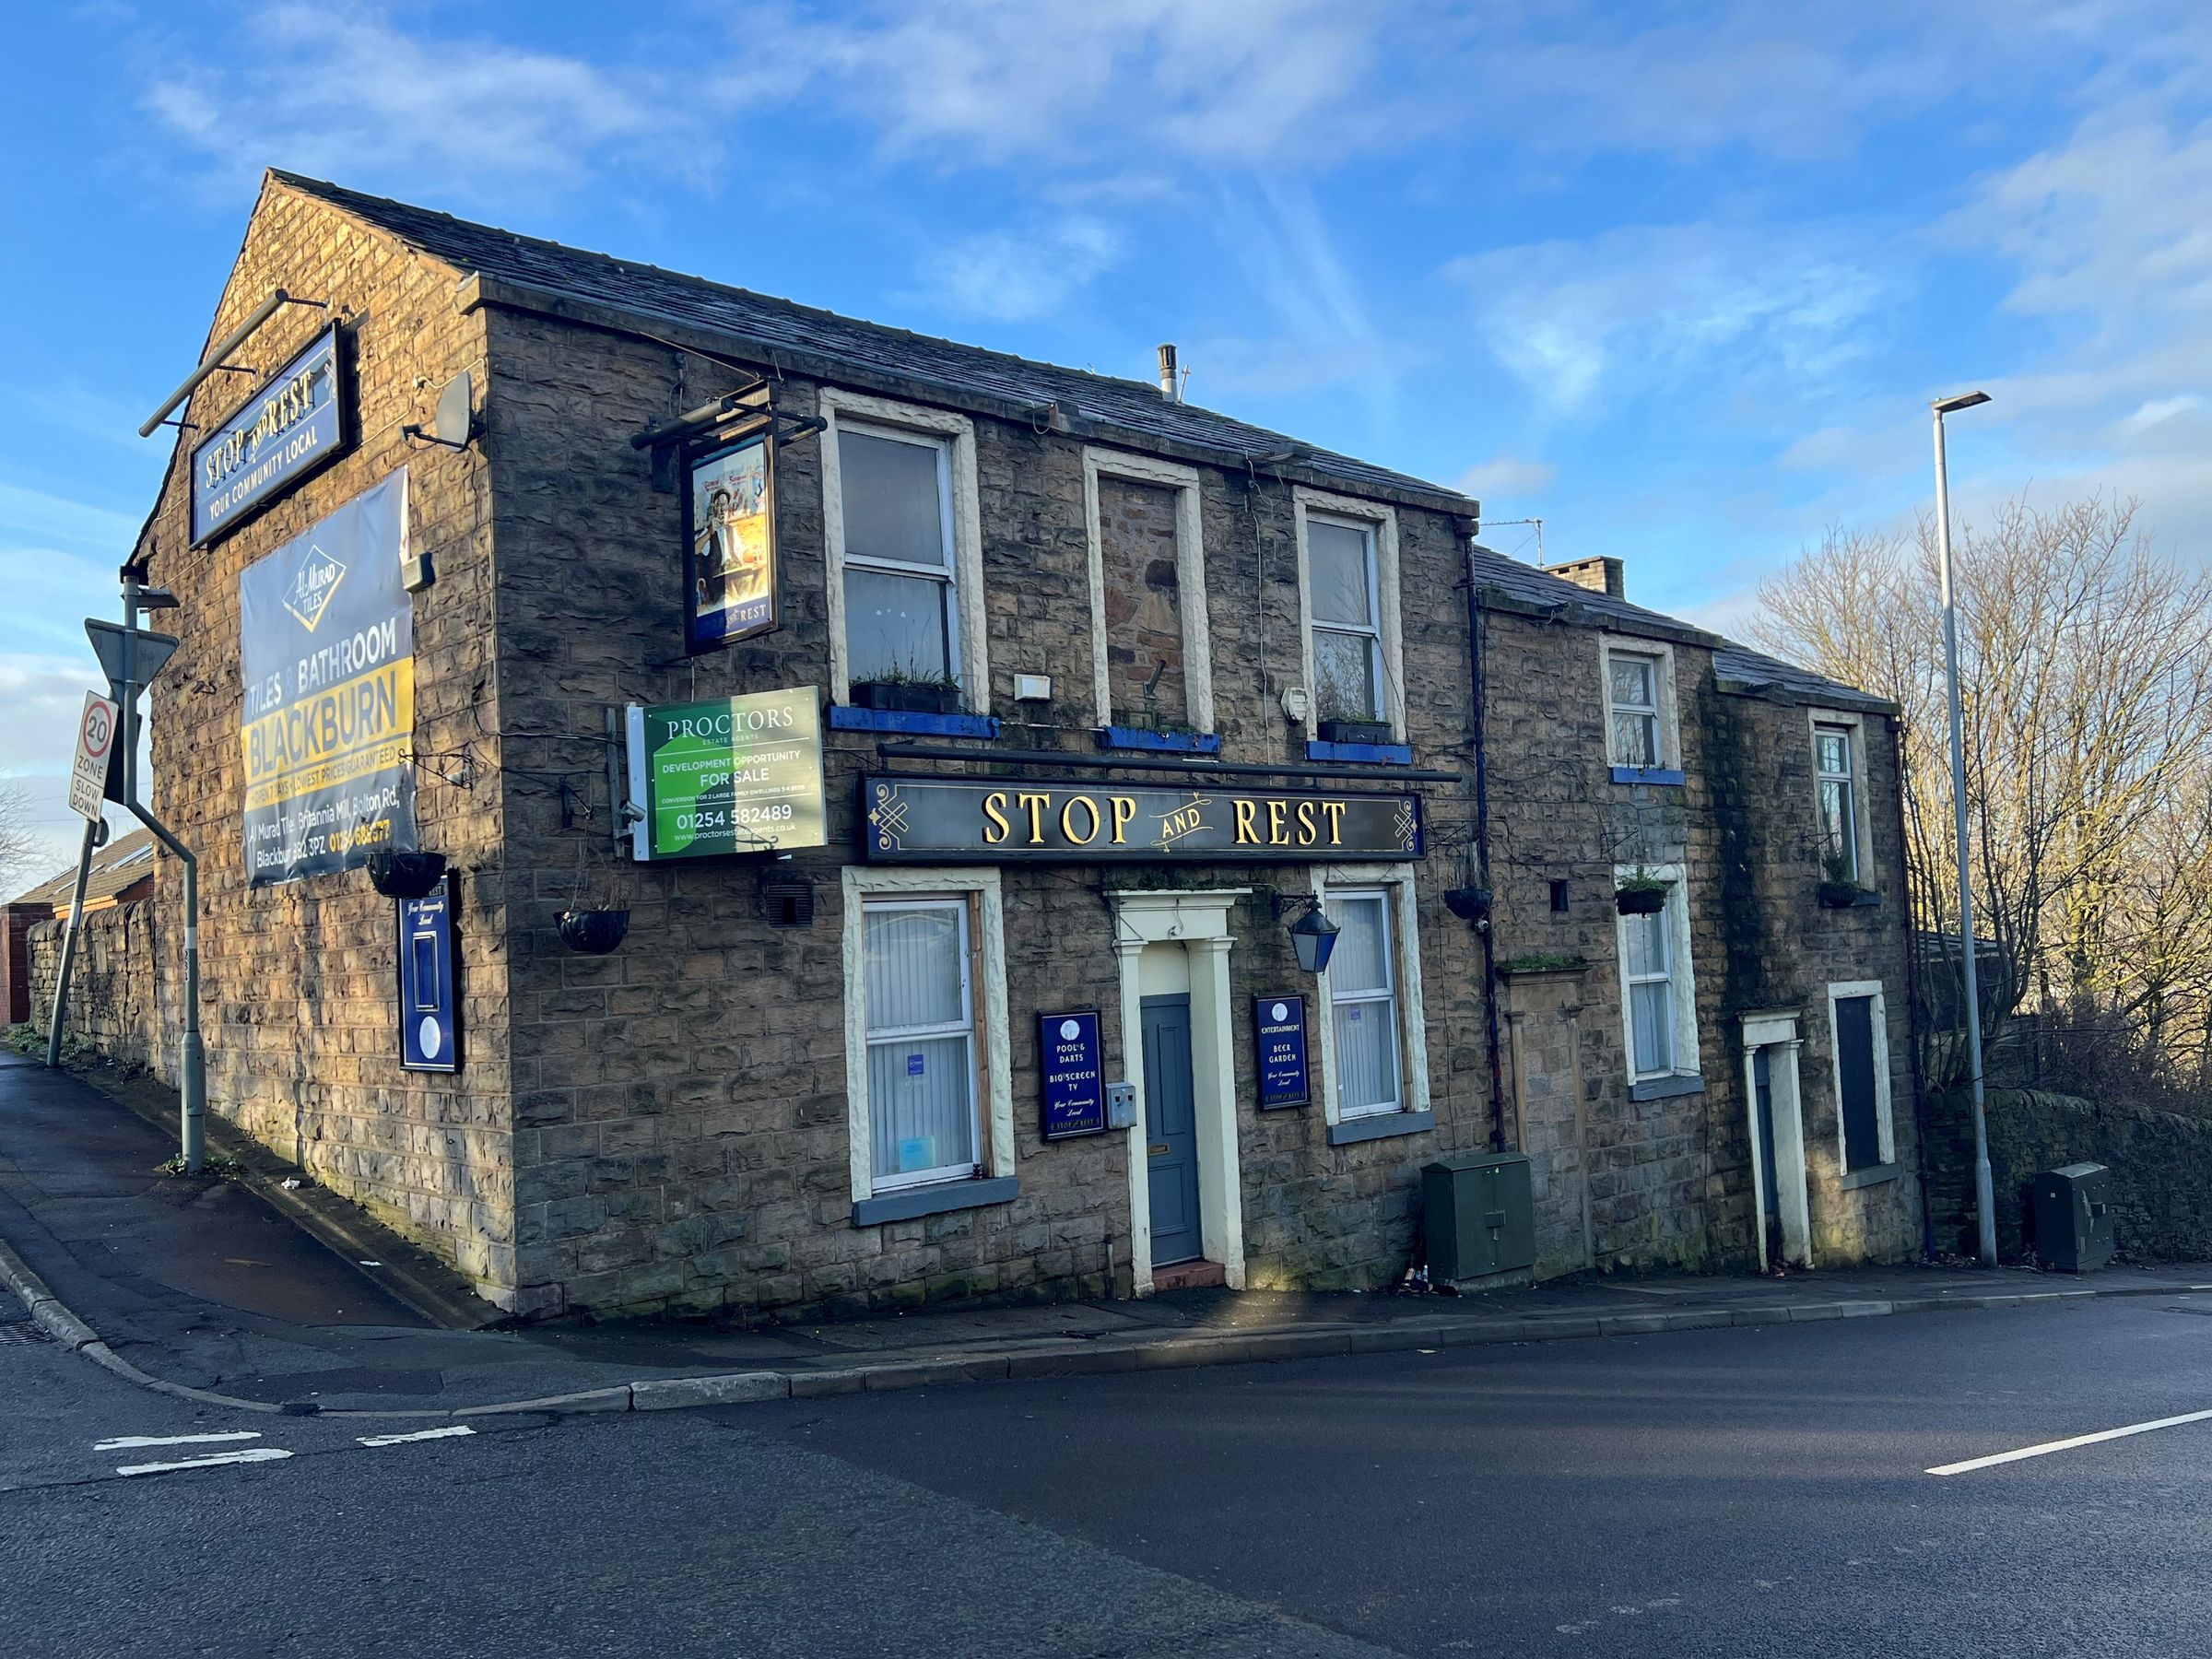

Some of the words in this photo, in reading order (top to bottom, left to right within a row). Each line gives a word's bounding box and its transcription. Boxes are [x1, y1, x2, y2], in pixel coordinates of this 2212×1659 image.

[206, 428, 244, 489] STOP
[252, 416, 269, 452] AND
[267, 370, 312, 438] REST
[209, 494, 230, 521] YOUR
[232, 453, 283, 504] COMMUNITY
[286, 425, 318, 465] LOCAL
[302, 590, 323, 615] TILES
[740, 604, 767, 622] REST
[250, 671, 281, 716] TILES
[285, 665, 294, 695] &
[298, 618, 396, 694] BATHROOM
[87, 715, 108, 744] 20
[250, 670, 396, 779] BLACKBURN
[667, 706, 794, 740] PROCTORS
[702, 736, 728, 746] ESTATE
[731, 734, 759, 743] AGENTS
[77, 755, 104, 780] ZONE
[662, 758, 731, 774] DEVELOPMENT
[733, 749, 801, 766] OPPORTUNITY
[76, 779, 100, 801] SLOW
[275, 781, 289, 798] AYS
[321, 764, 346, 783] PRICES
[700, 772, 729, 788] FOR
[733, 767, 771, 784] SALE
[72, 794, 98, 818] DOWN
[661, 796, 696, 805] CONVERSION
[730, 791, 749, 799] FAMILY
[258, 818, 280, 841] Murad
[298, 803, 335, 830] Britannia
[352, 793, 381, 816] Bolton
[382, 784, 400, 809] Rd,
[677, 810, 725, 830] 01254
[730, 804, 793, 825] 582489
[983, 792, 1137, 844] STOP
[1162, 807, 1201, 839] AND
[1232, 799, 1347, 845] REST
[256, 847, 293, 868] Blackbur
[308, 835, 326, 857] 3PZ
[1261, 1024, 1300, 1034] ENTERTAINMENT
[1056, 1043, 1077, 1053] POOL
[1079, 1042, 1086, 1051] &
[1059, 1053, 1084, 1064] DARTS
[1268, 1053, 1297, 1064] GARDEN
[1273, 1043, 1291, 1053] BEER
[1049, 1074, 1064, 1083] BIG
[1065, 1070, 1096, 1081] SCREEN
[1068, 1083, 1078, 1091] TV
